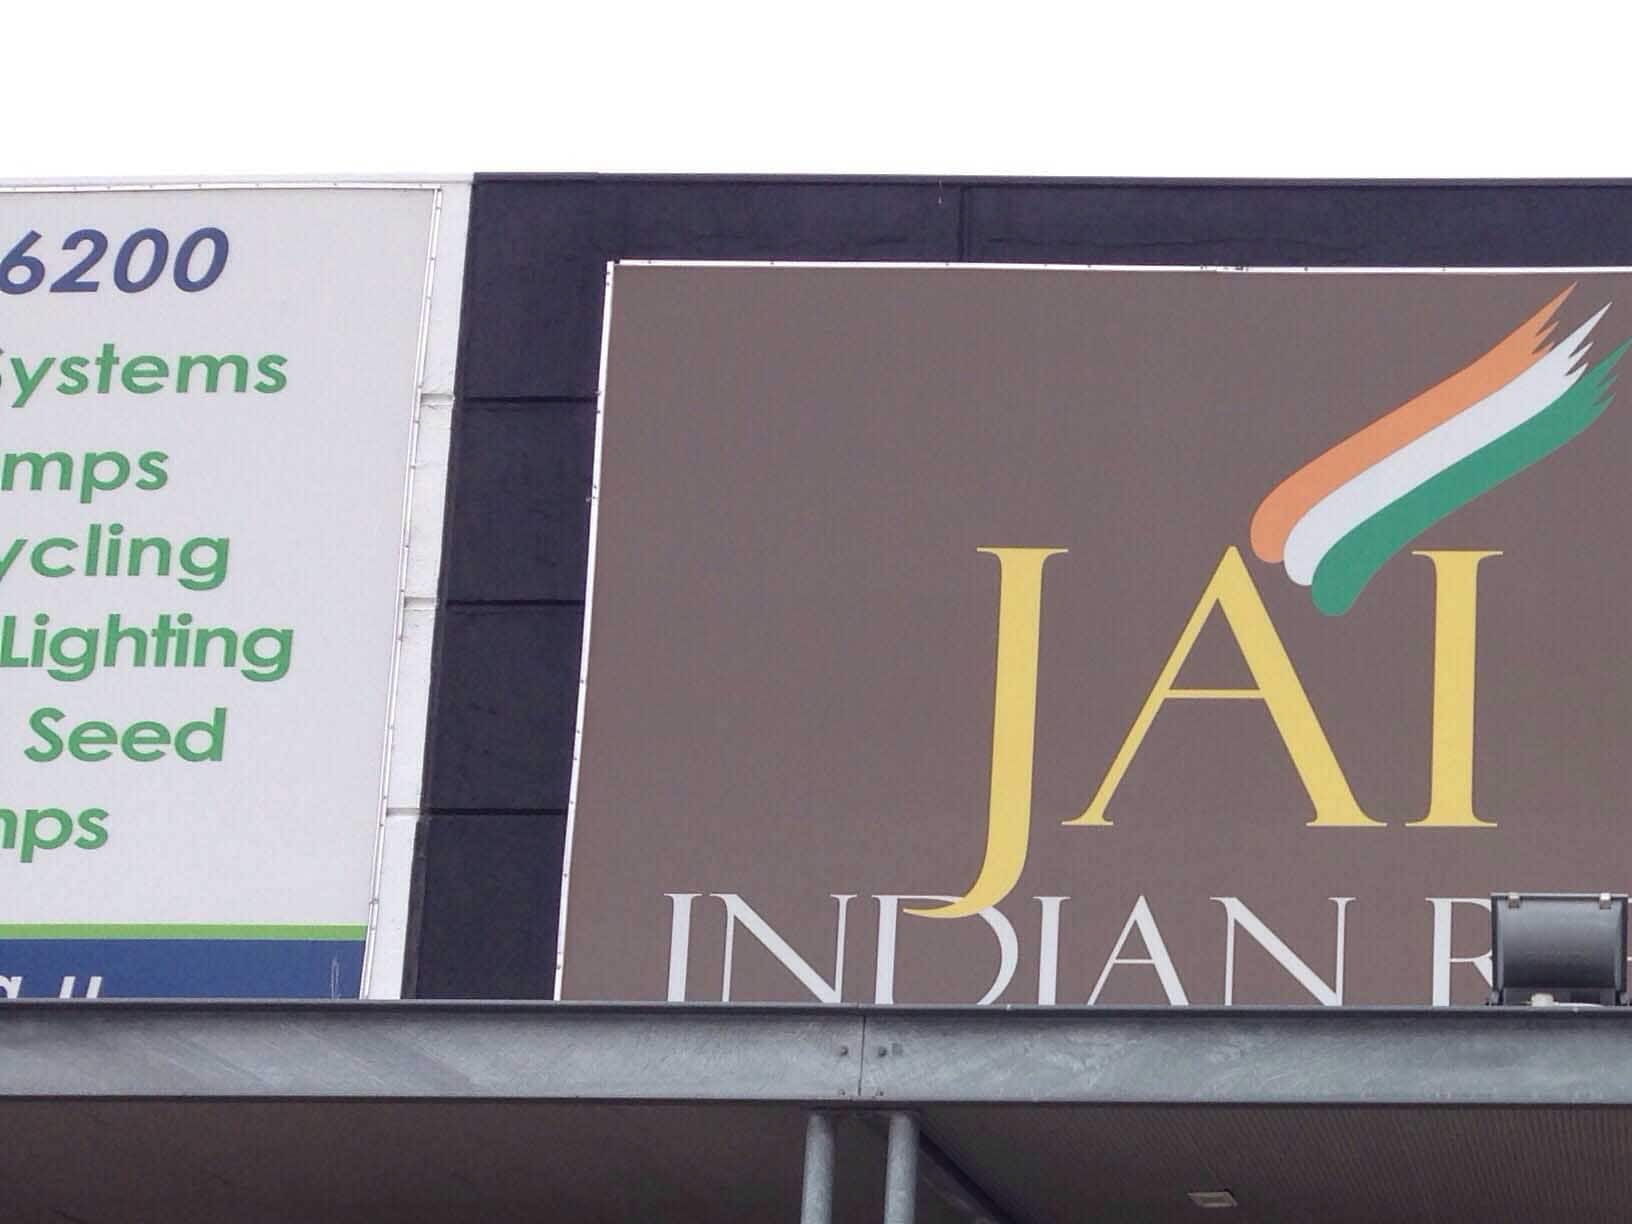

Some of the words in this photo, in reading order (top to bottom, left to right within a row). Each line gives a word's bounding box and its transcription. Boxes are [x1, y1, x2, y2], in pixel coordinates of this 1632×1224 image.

[0, 227, 229, 295] 6200
[0, 343, 288, 408] ystems
[0, 613, 294, 682] Lighting
[24, 706, 228, 762] Seed
[902, 546, 1503, 918] JAI
[0, 807, 109, 863] ps
[663, 892, 1356, 1006] INDIAN
